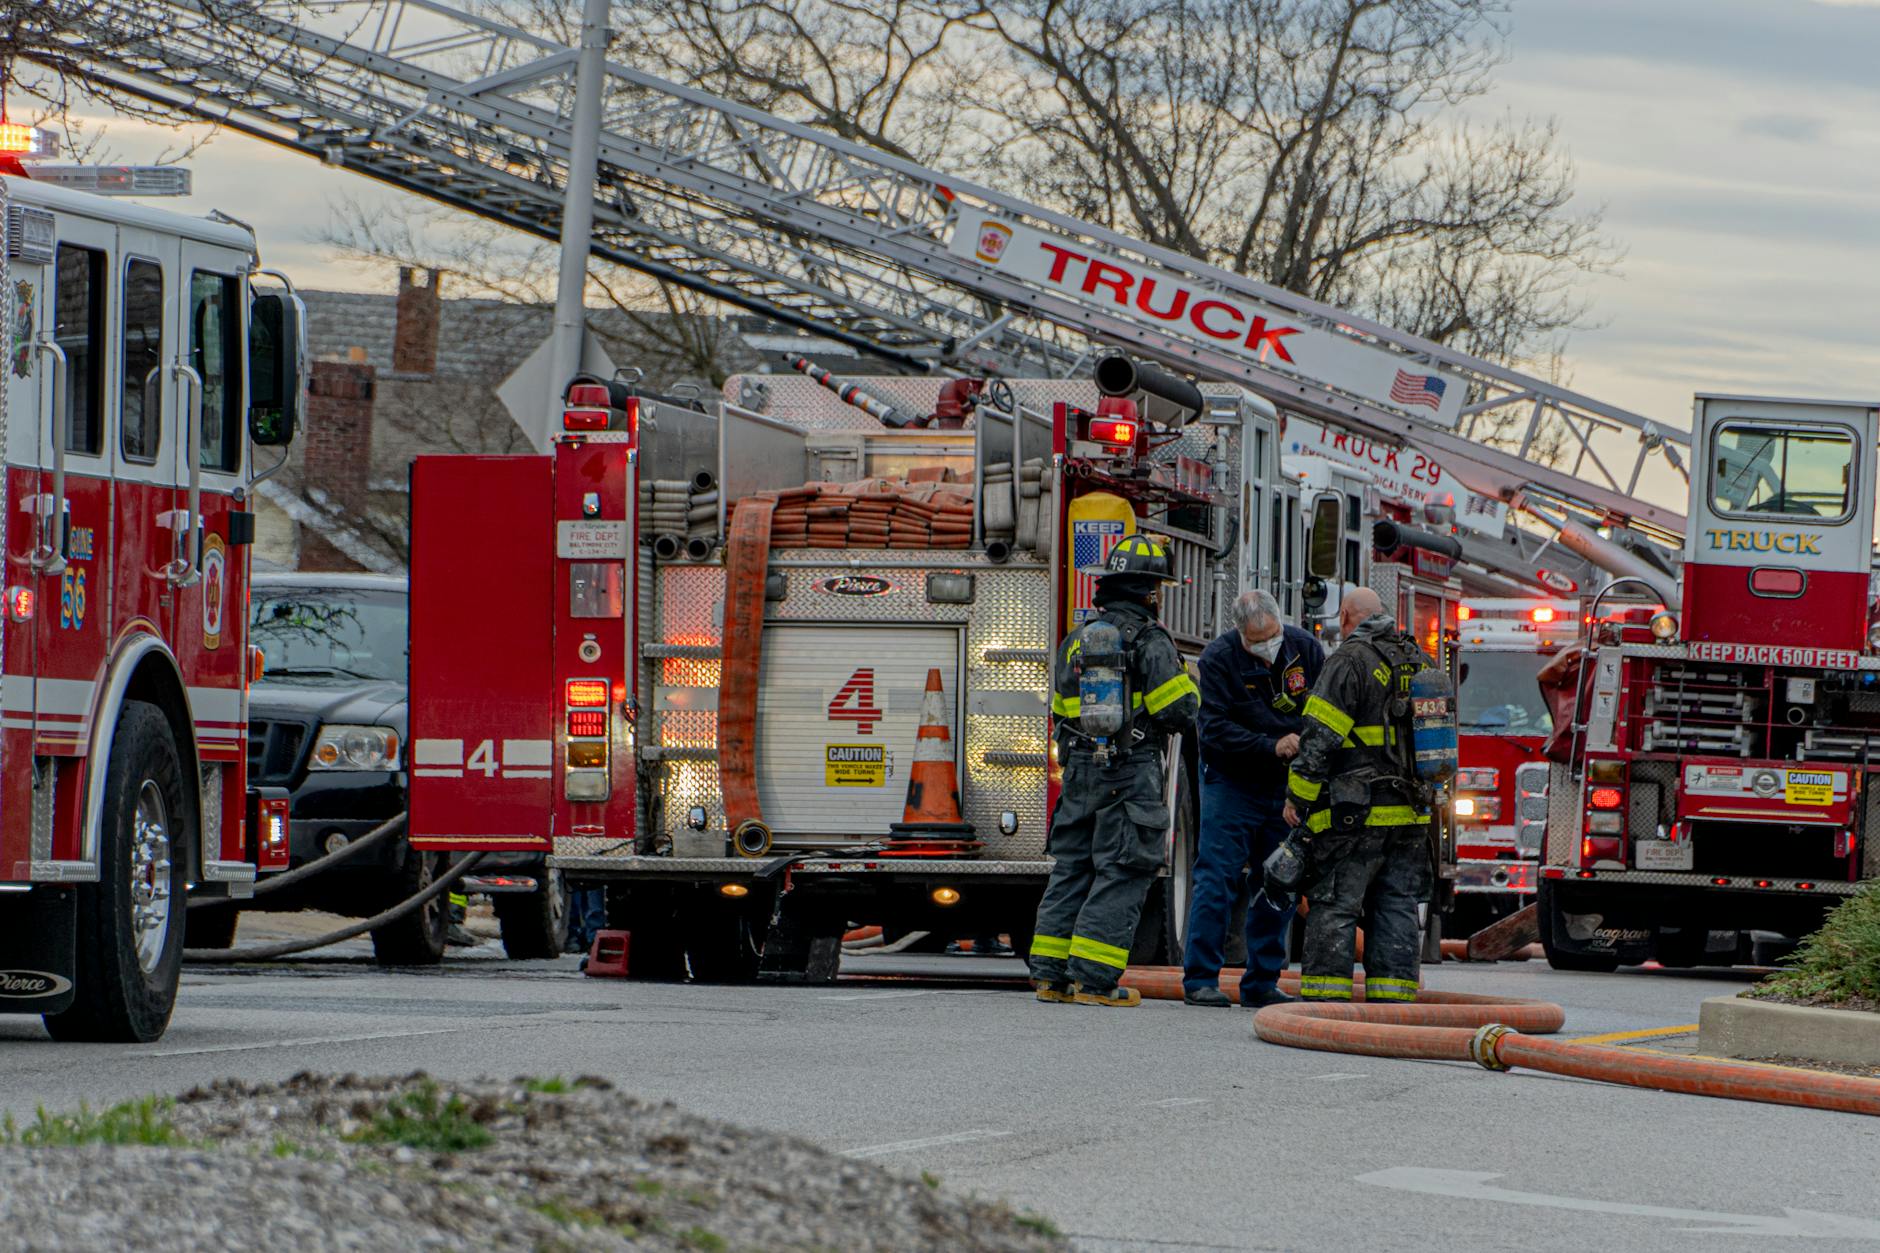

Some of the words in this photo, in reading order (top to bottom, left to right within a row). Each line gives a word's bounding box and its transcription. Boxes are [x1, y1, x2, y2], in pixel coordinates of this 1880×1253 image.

[1040, 242, 1305, 366] TRUCK
[1319, 427, 1400, 473] TRUCK
[1410, 454, 1442, 486] 29
[570, 531, 592, 541] FIRE
[1074, 522, 1123, 534] KEEP
[1705, 528, 1823, 555] TRUCK
[1110, 558, 1127, 572] 43
[833, 577, 881, 593] Pierce
[61, 566, 86, 631] 56
[1073, 610, 1097, 623] BA
[1688, 643, 1735, 662] KEEP
[1735, 645, 1780, 665] BACK
[1782, 648, 1813, 666] 500
[1815, 650, 1858, 669] FEET
[828, 668, 882, 735] 4
[467, 739, 499, 777] 4
[829, 747, 882, 761] CAUTION
[1789, 773, 1832, 785] CAUTION
